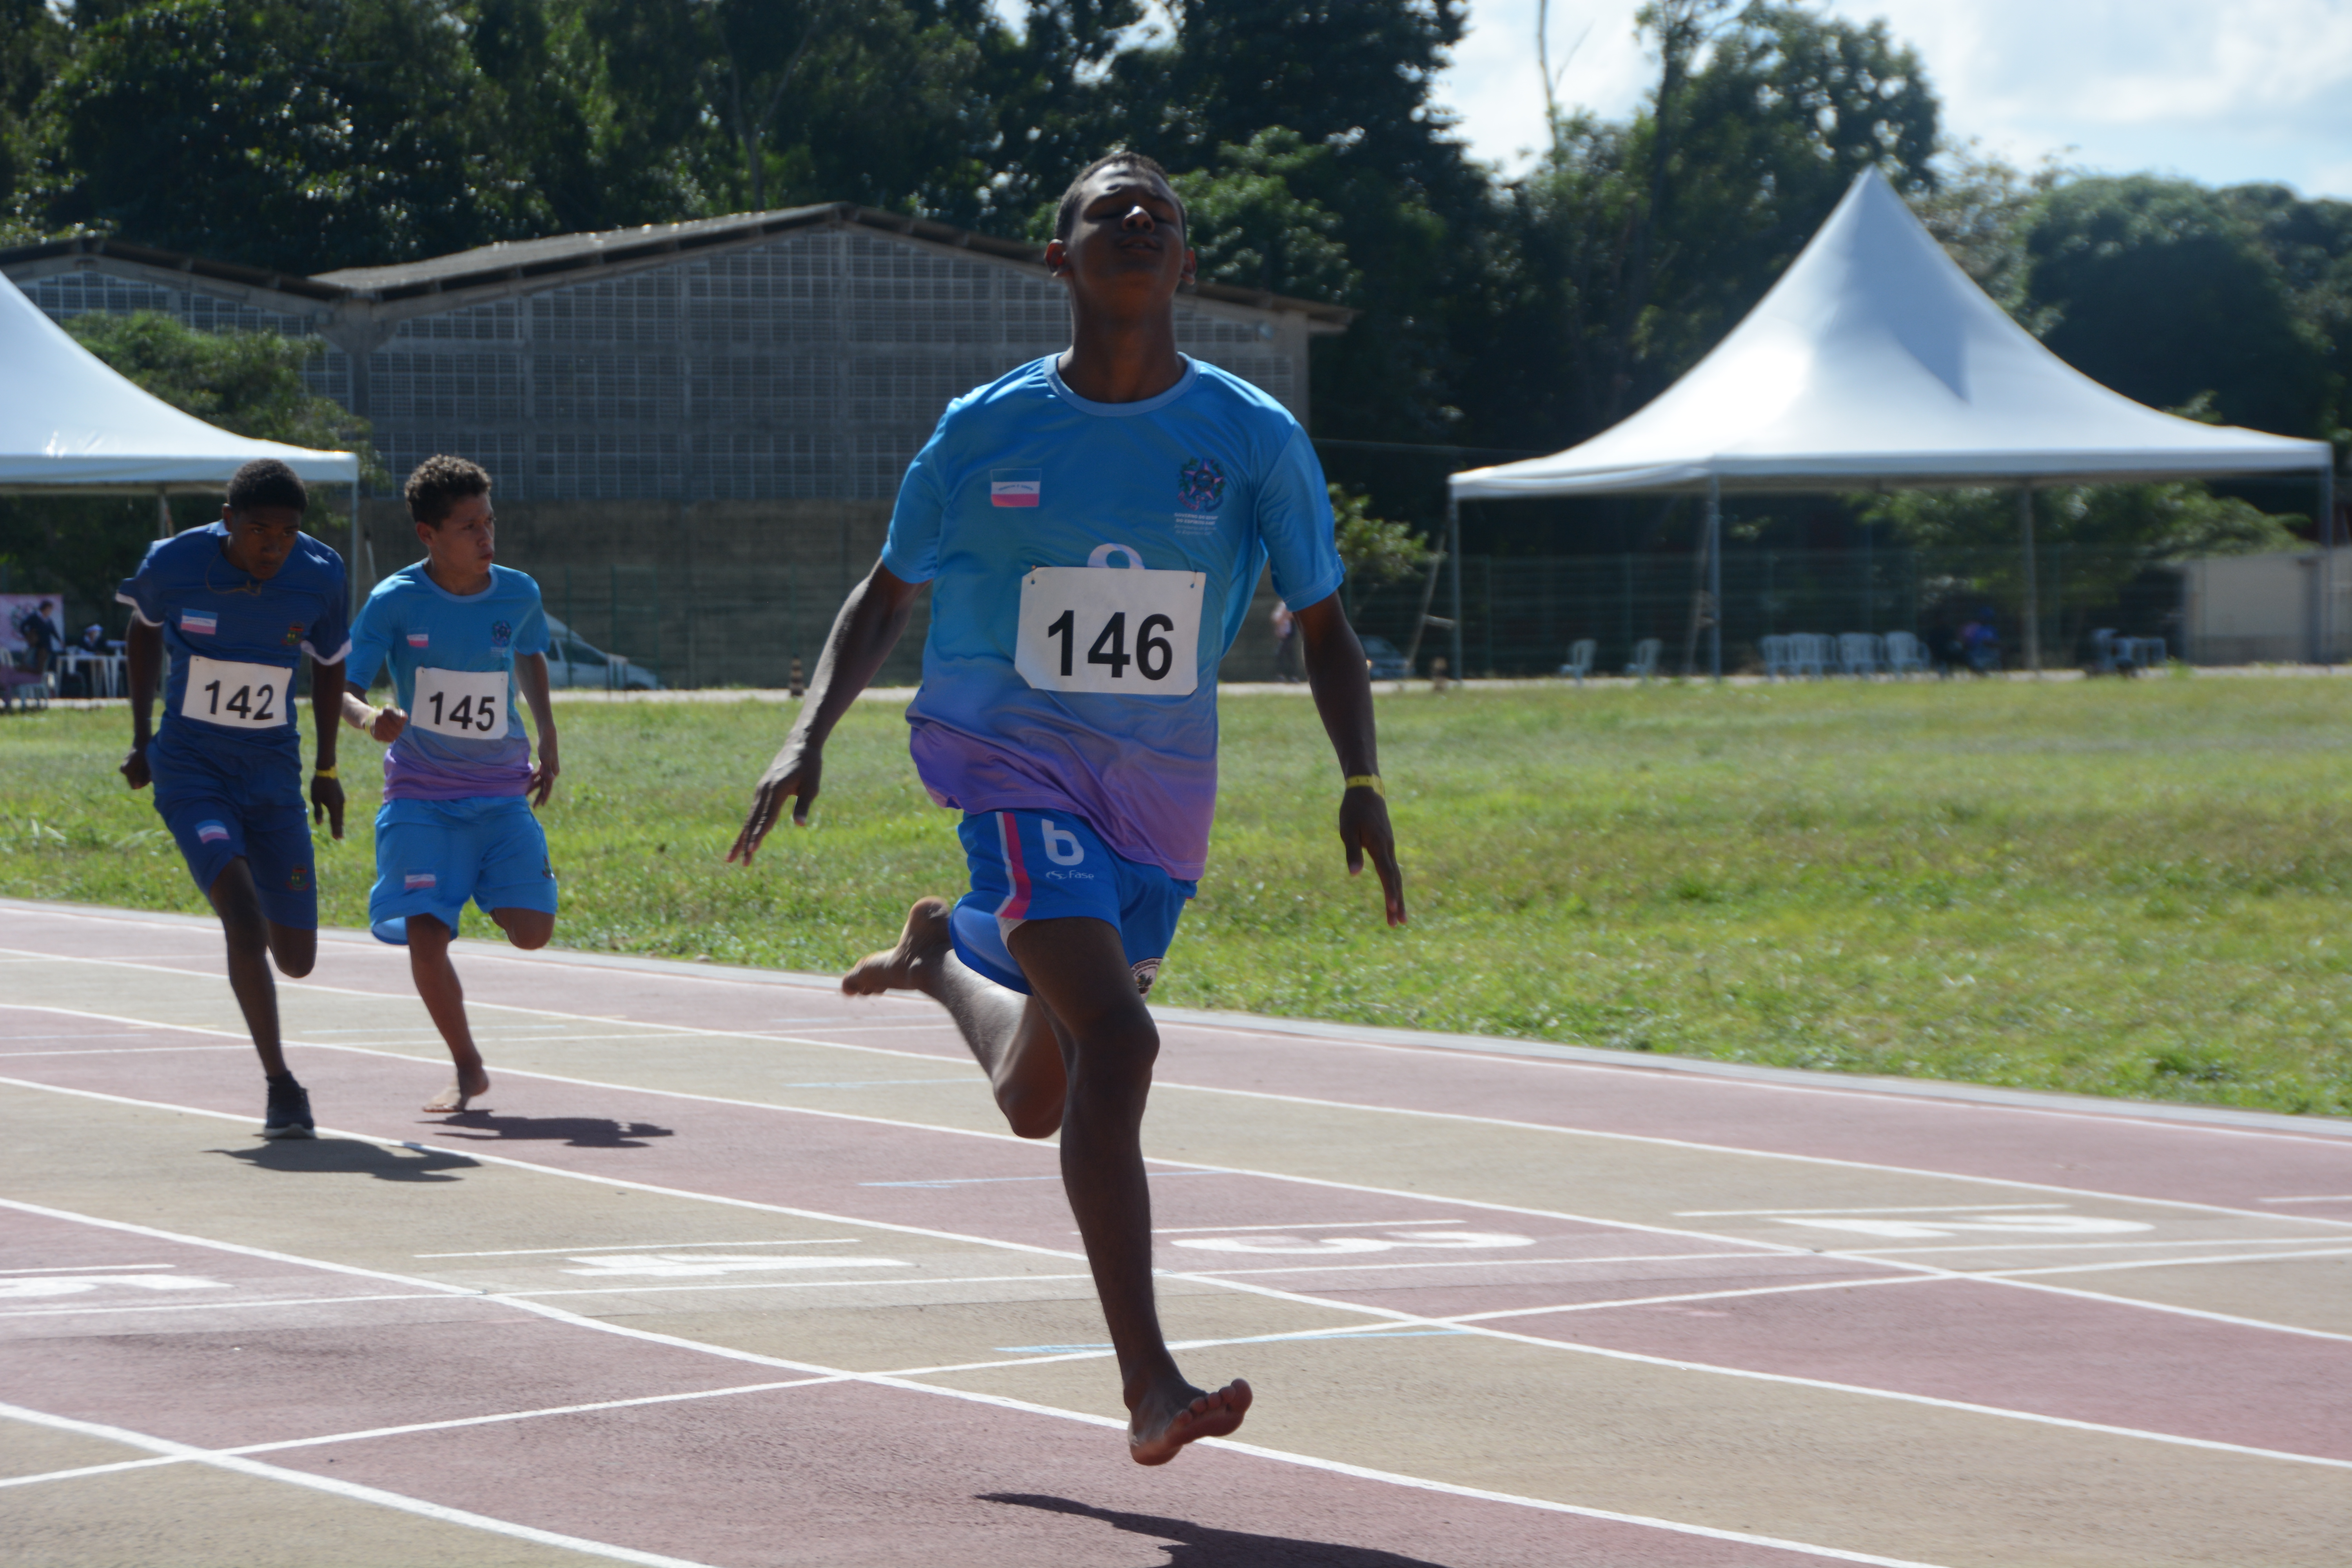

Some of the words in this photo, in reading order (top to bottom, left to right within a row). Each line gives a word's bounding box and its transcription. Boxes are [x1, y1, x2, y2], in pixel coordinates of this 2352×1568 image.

[1048, 610, 1174, 681] 146
[205, 680, 274, 721] 142
[429, 691, 495, 731] 145
[1069, 870, 1094, 879] Fase
